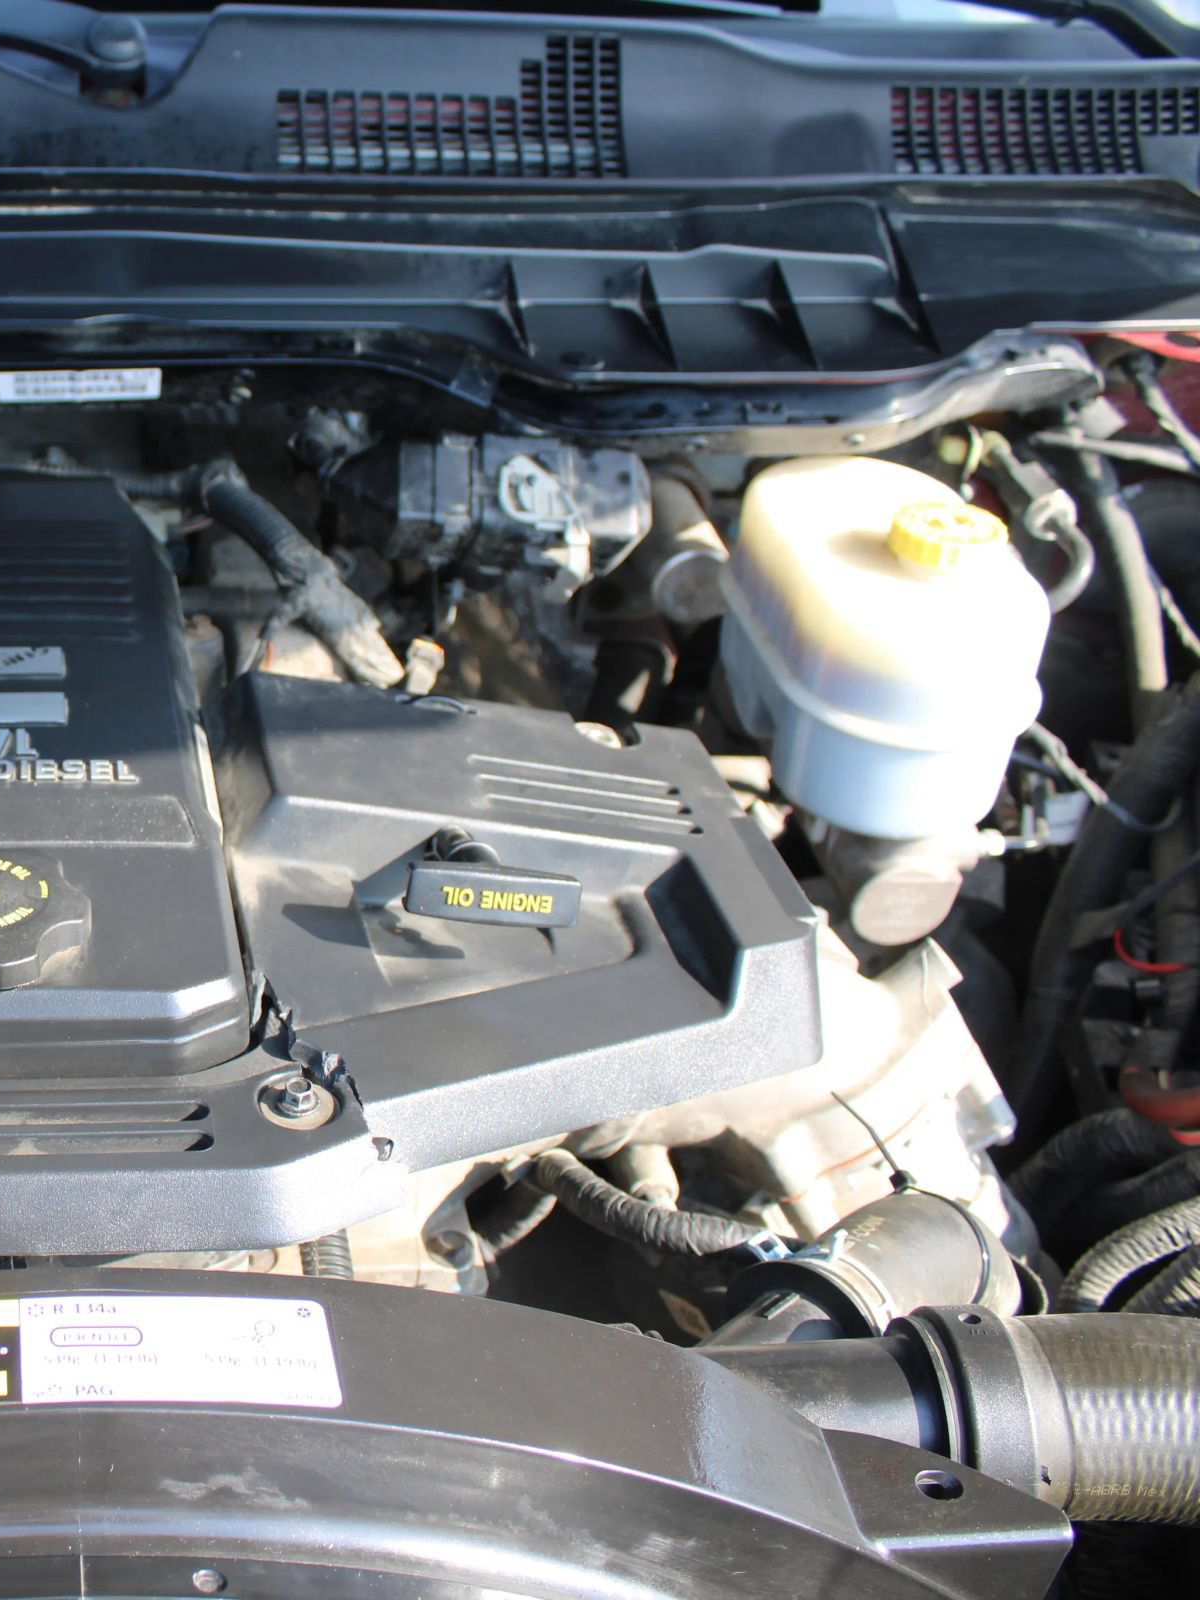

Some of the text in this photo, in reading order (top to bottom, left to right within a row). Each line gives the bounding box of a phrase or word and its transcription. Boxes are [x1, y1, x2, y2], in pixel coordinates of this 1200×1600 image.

[9, 865, 32, 881] OIL
[440, 885, 554, 914] ENGINE OIL
[74, 1383, 113, 1397] PAG
